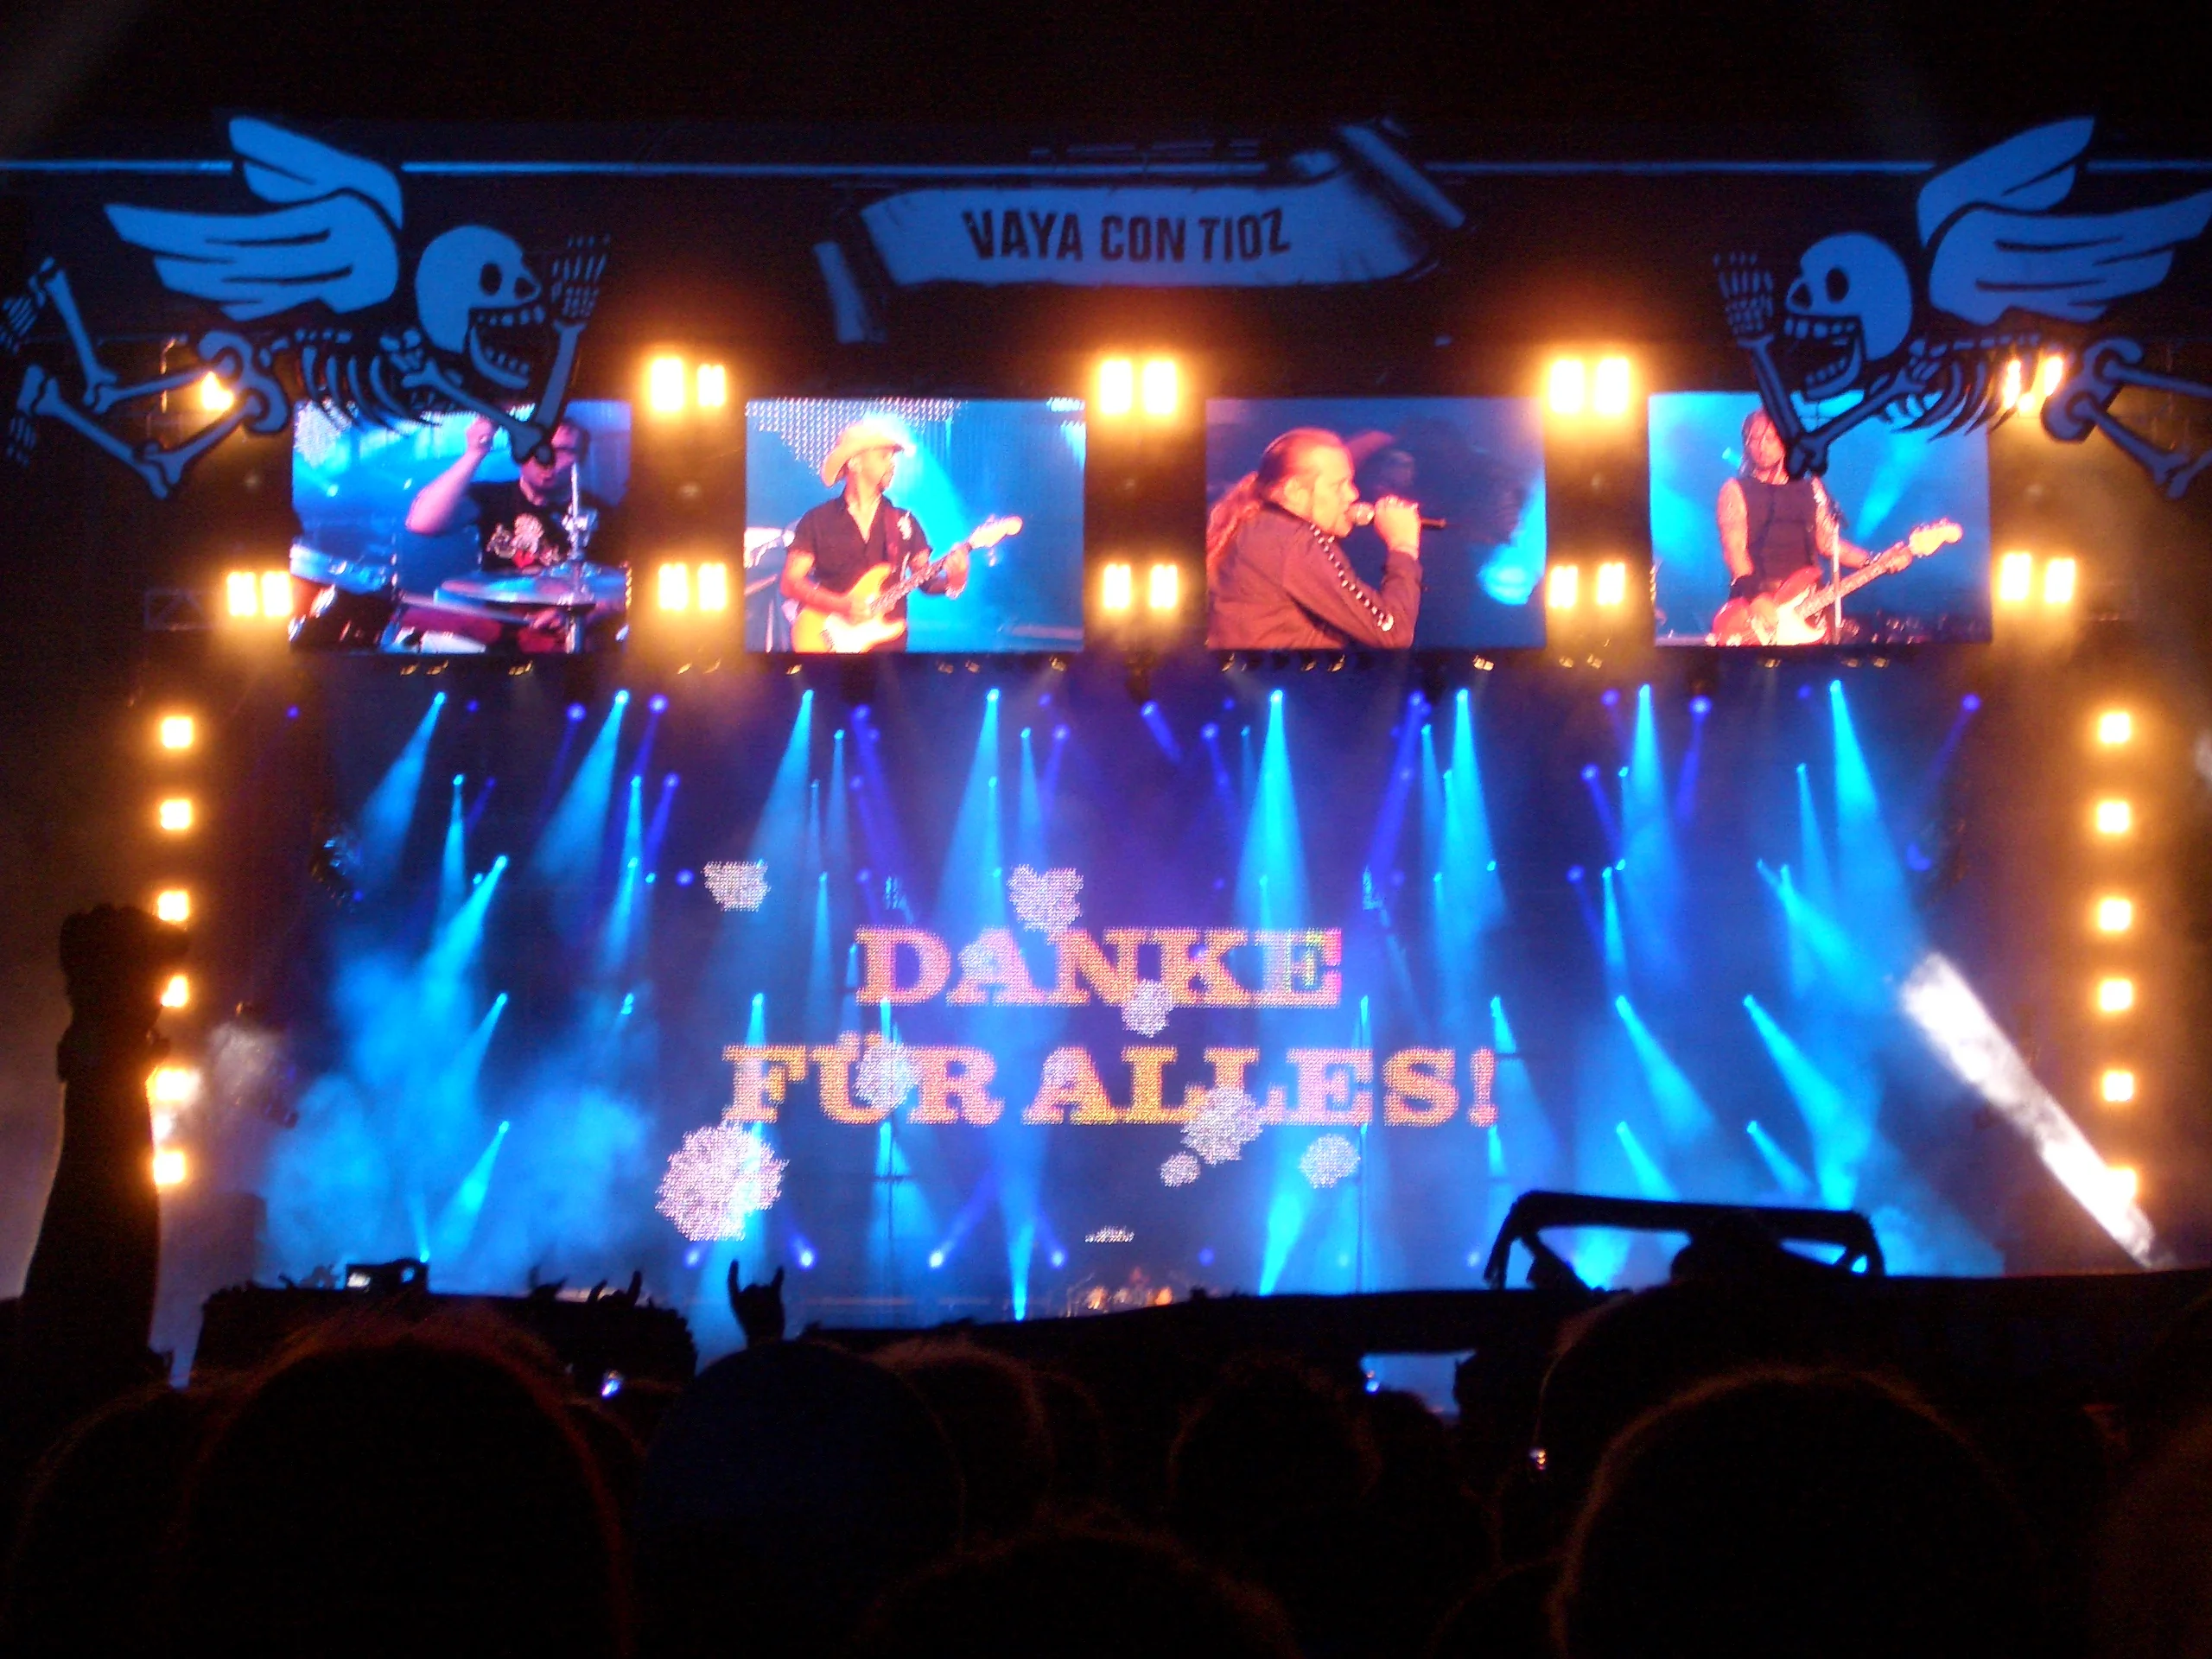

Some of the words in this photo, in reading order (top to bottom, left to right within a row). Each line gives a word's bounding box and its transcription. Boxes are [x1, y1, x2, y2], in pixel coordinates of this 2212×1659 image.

[963, 209, 1083, 260] VAYA
[1101, 214, 1186, 262] CON
[1198, 207, 1291, 261] TIOZ
[855, 927, 1342, 1008] DANKE
[721, 1032, 1004, 1126] FÜR
